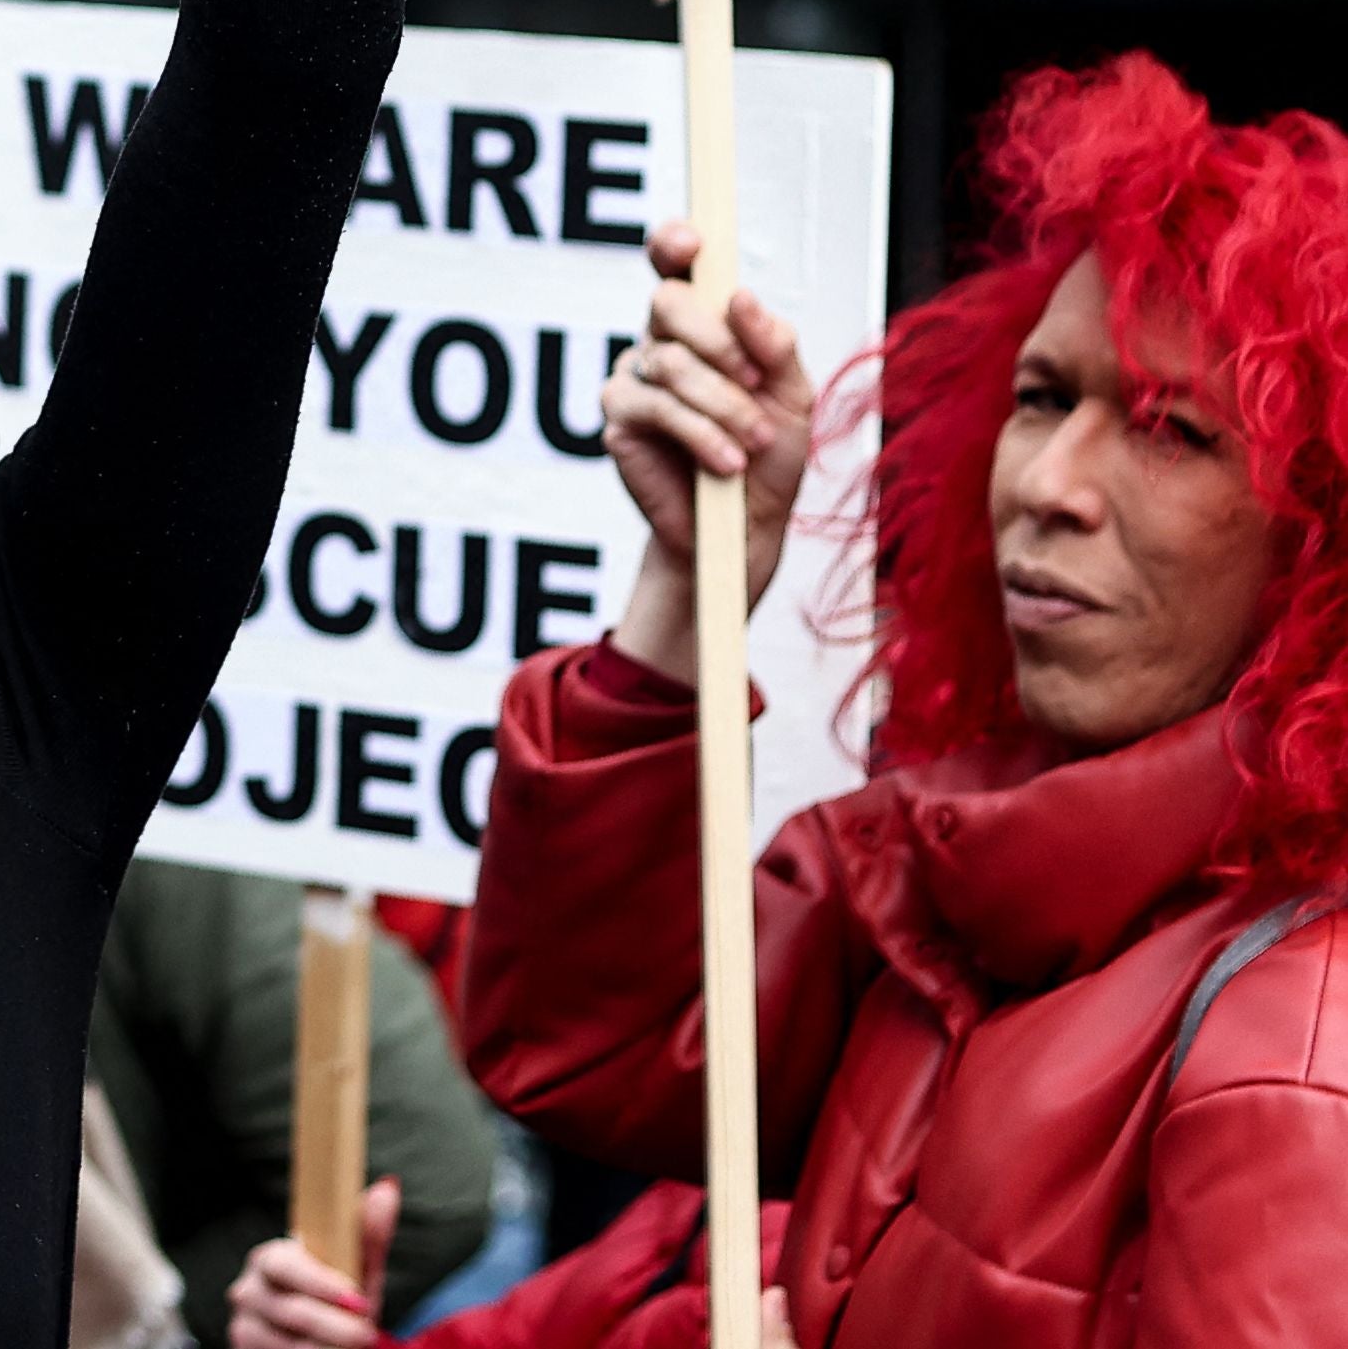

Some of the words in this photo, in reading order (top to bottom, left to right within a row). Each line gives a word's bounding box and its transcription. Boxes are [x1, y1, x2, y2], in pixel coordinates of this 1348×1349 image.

[23, 71, 157, 195] W
[349, 104, 650, 248] ARE
[313, 310, 637, 459] YOU
[241, 511, 601, 661] CUE
